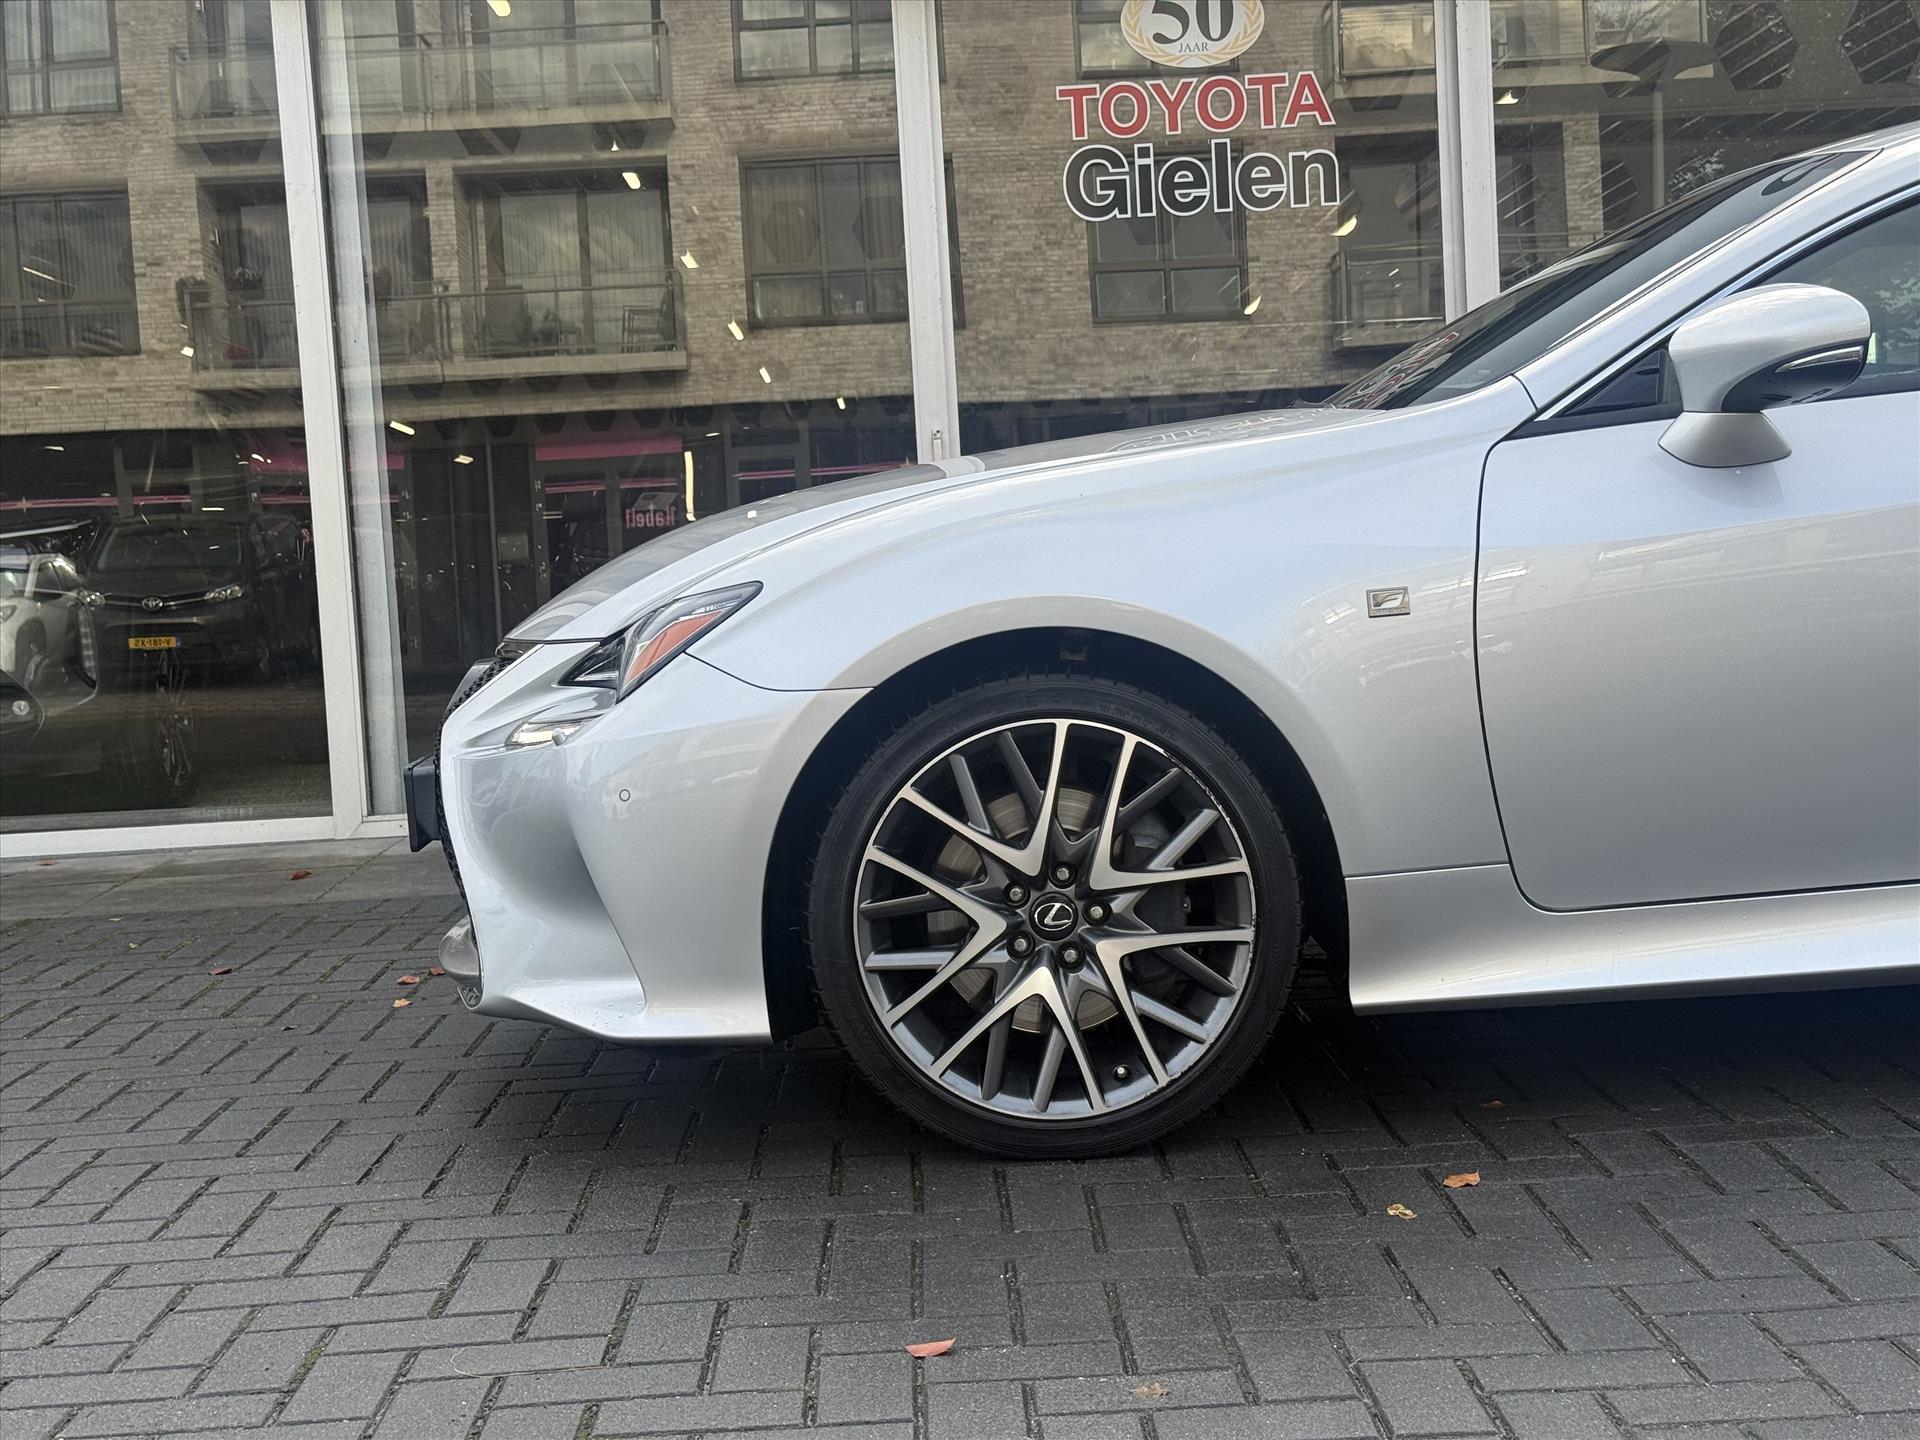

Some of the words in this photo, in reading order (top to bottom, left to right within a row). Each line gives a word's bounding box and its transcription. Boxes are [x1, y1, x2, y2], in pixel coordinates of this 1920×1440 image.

[1151, 0, 1234, 45] 50
[1178, 42, 1209, 54] JAAR
[1056, 71, 1336, 140] TOYOTA
[1063, 138, 1341, 222] Gielen
